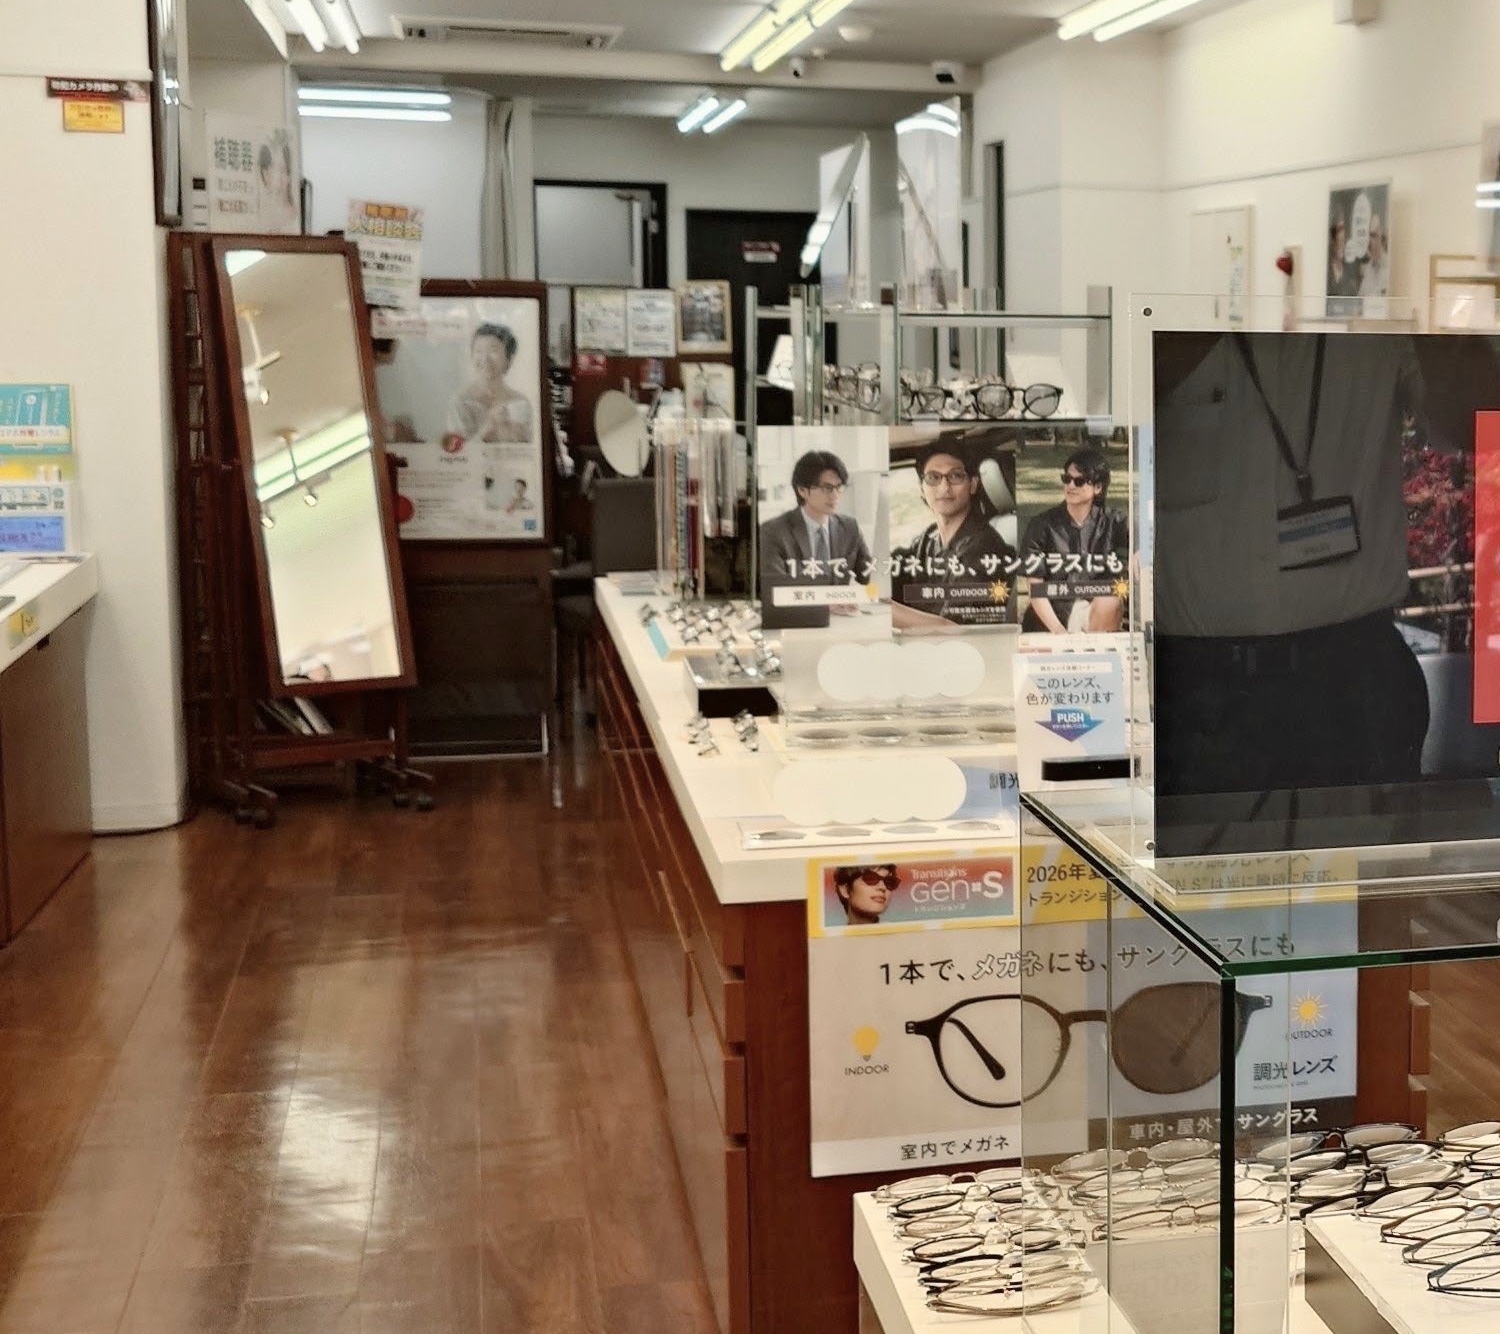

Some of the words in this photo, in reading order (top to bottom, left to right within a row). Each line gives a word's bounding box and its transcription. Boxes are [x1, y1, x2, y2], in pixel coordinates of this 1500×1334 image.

[950, 588, 988, 598] OUTDOOR
[1074, 585, 1112, 595] OUTDOOR
[1036, 676, 1102, 690] このレンズ、
[1026, 692, 1114, 706] 色が変わります
[1057, 713, 1084, 723] PUSH
[844, 1063, 890, 1075] INDOOR
[1253, 1054, 1339, 1082] 調光レンズ
[1129, 1107, 1319, 1140] 車内・屋外サングラス
[900, 1135, 1010, 1161] 室内でメガネ
